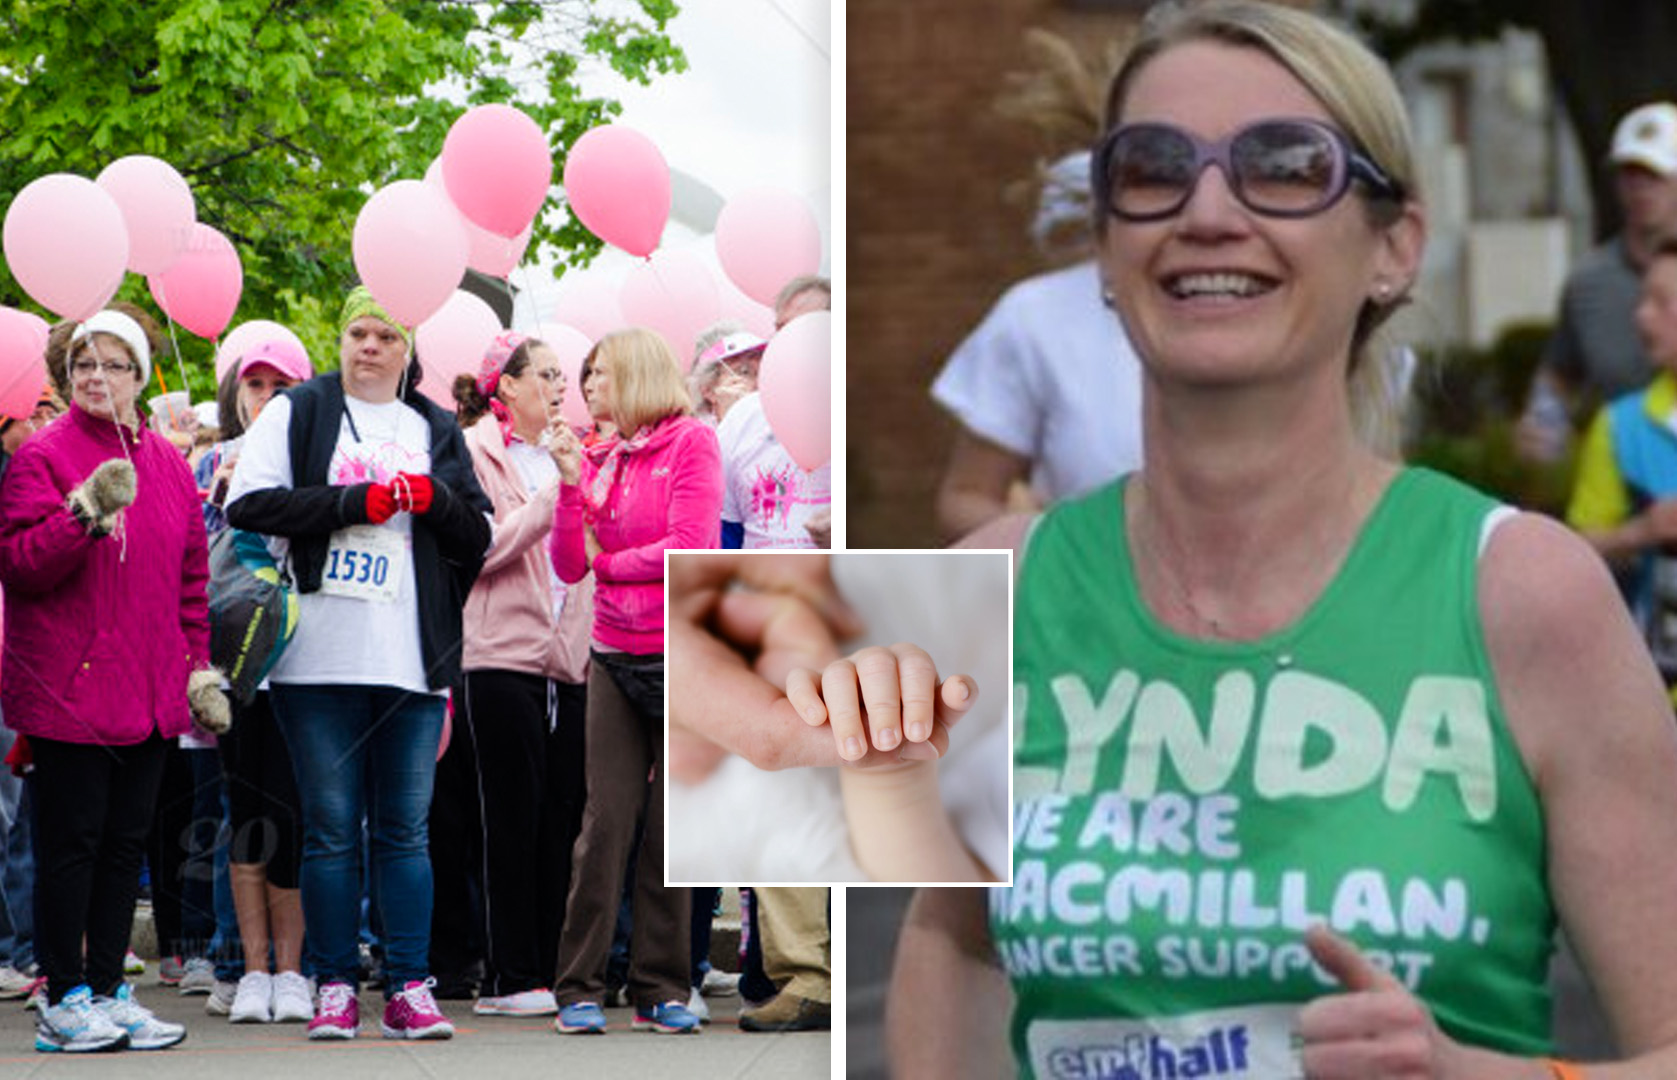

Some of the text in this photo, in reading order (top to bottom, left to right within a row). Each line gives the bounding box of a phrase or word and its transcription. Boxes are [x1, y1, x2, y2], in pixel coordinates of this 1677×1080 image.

[326, 549, 389, 587] 1530
[1013, 668, 1497, 821] LYNDA
[1077, 790, 1241, 859] ARE
